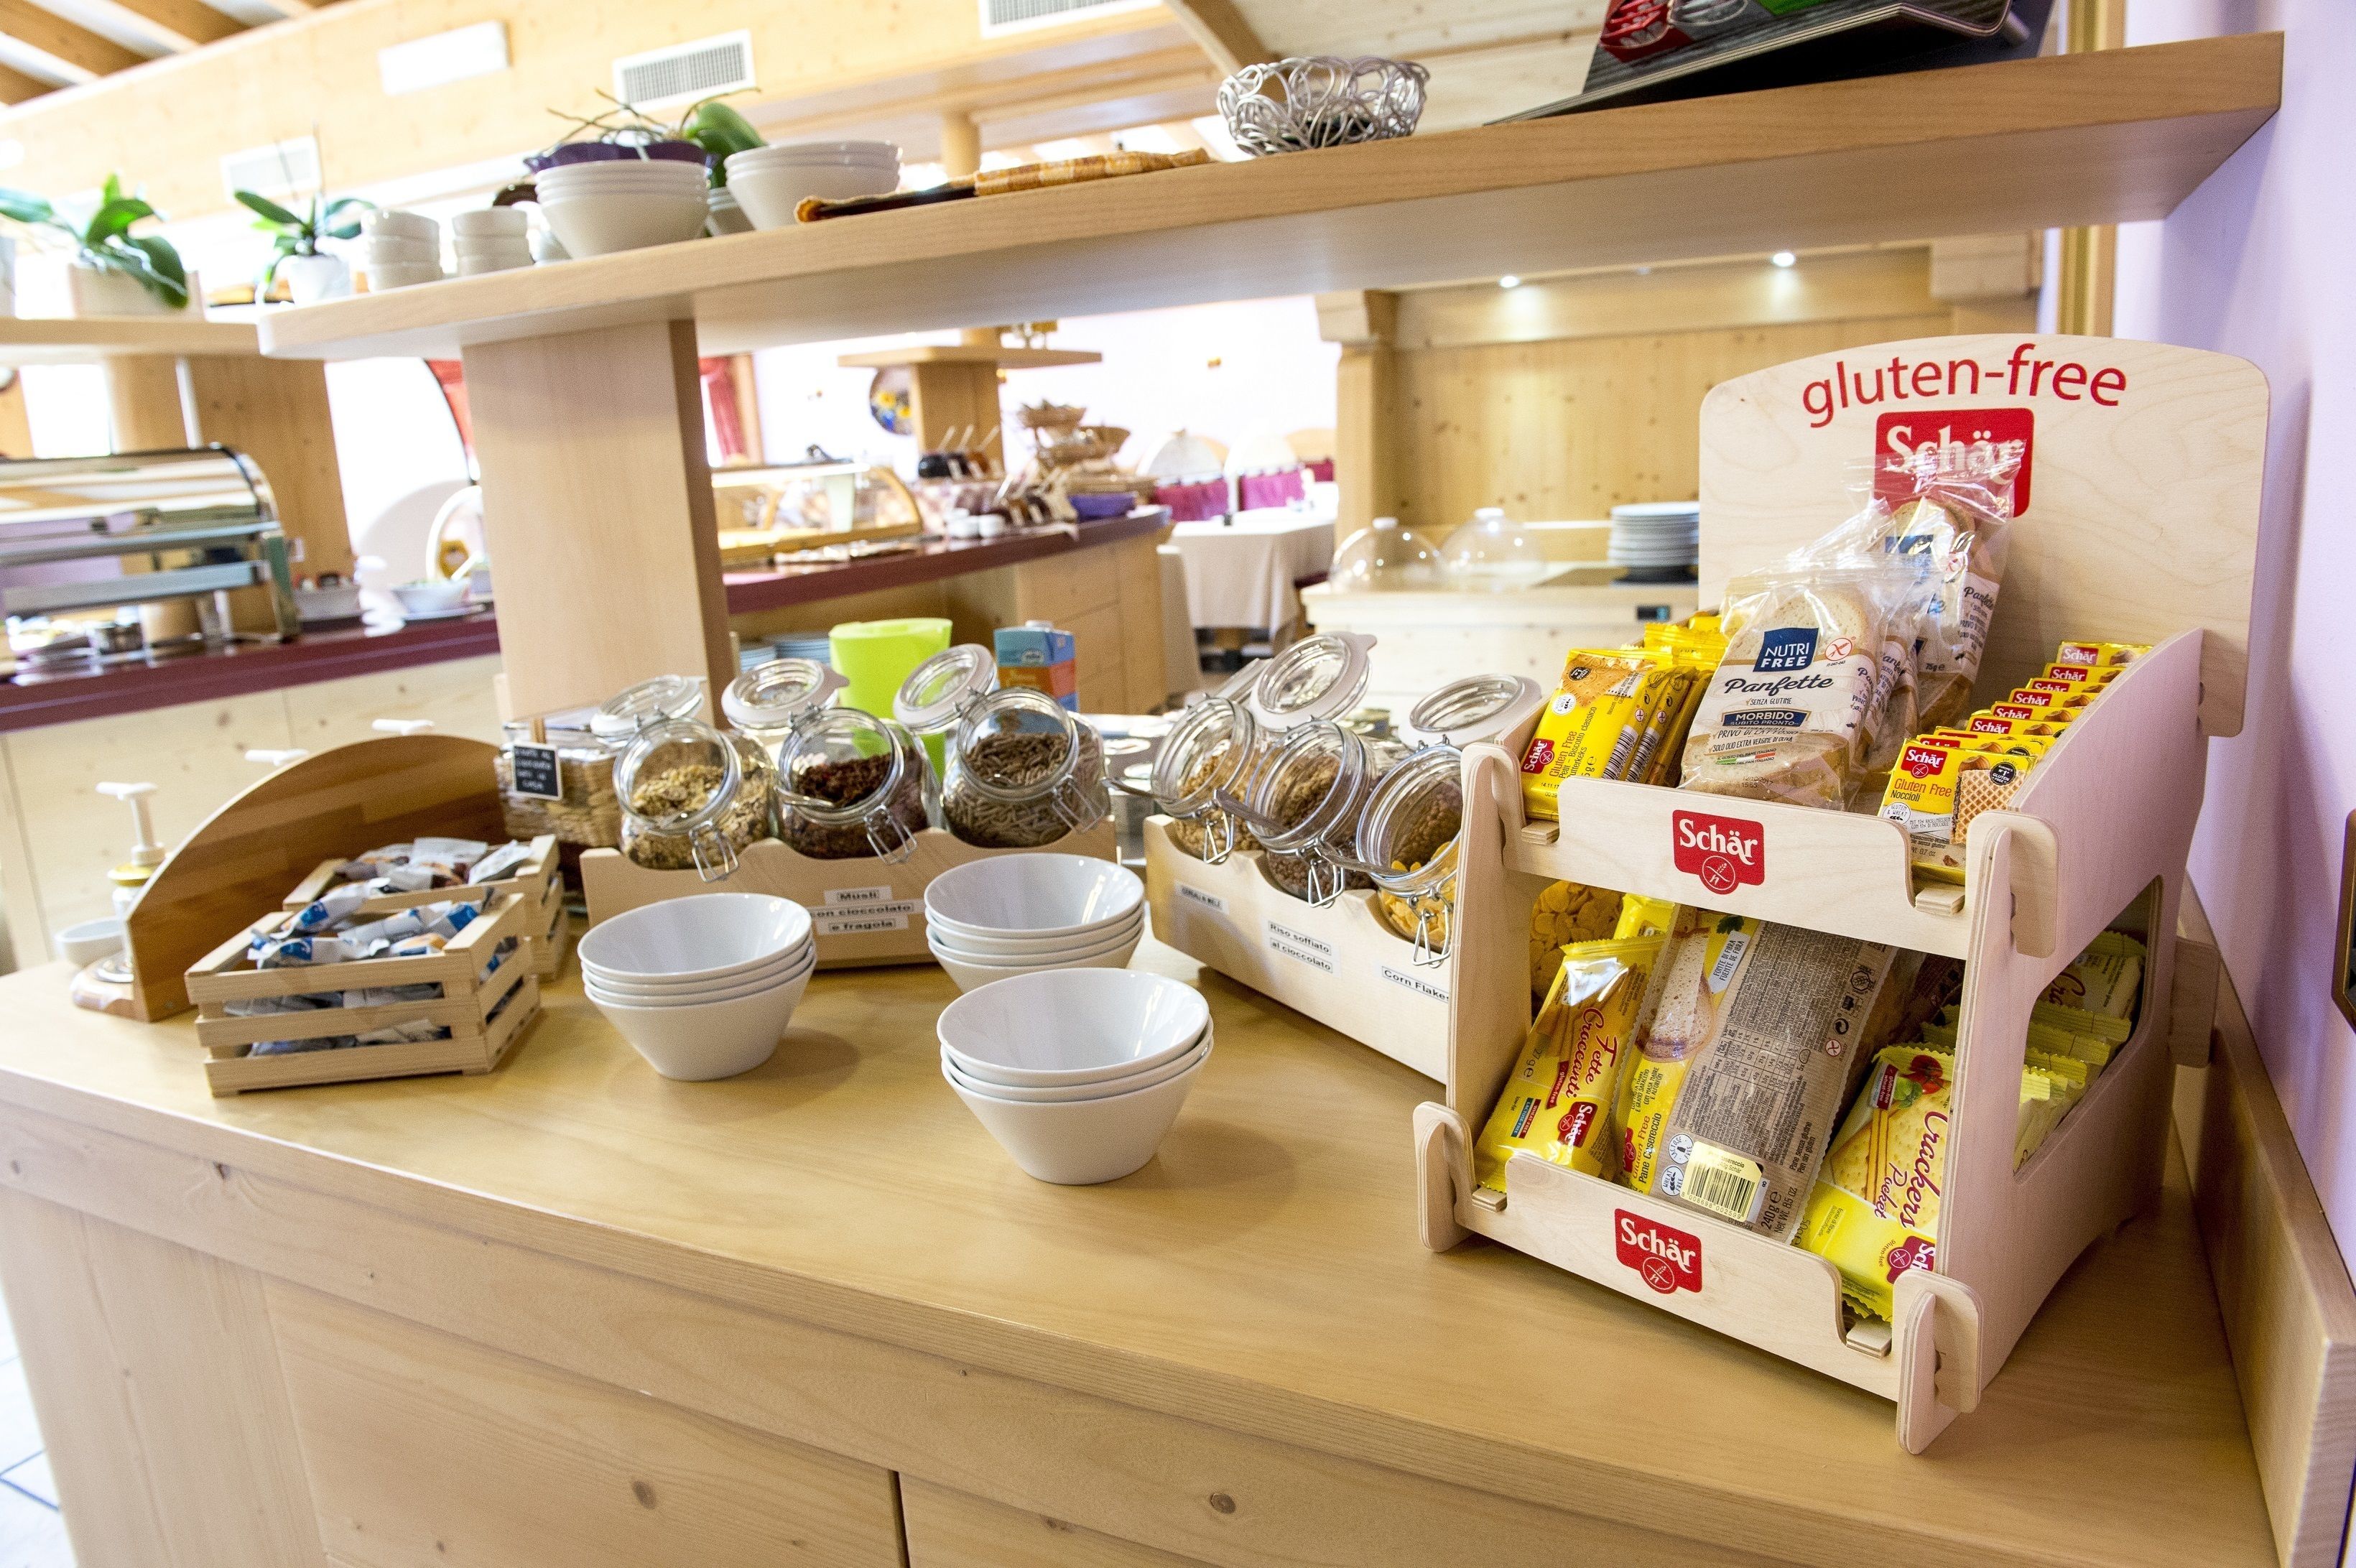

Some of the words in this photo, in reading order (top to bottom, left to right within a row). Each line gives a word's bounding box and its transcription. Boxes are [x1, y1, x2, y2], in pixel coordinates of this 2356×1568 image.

[1802, 343, 2126, 428] gluten-free
[1884, 424, 2026, 486] Schär
[1761, 657, 1807, 669] FREE
[1765, 642, 1810, 658] NUTRI
[2062, 648, 2097, 663] Schär
[1724, 674, 1834, 696] Panfette
[2051, 669, 2085, 682] Schär
[2014, 692, 2049, 706] Schär
[1735, 711, 1794, 721] MORBIDO
[1972, 720, 2009, 734] Schär
[1995, 708, 2029, 720] Schär
[1567, 729, 1585, 759] Biscotto
[1581, 706, 1597, 733] classico
[1717, 730, 1740, 739] PRIVO
[1736, 739, 1752, 748] EXTRA
[1523, 740, 1548, 771] Schär
[1549, 747, 1568, 778] Gluten
[1562, 730, 1577, 749] Free
[1906, 749, 1944, 768] Schär
[1890, 790, 1921, 802] Noccioli
[1894, 778, 1926, 793] Gluten
[1929, 783, 1952, 797] Free
[1679, 818, 1758, 866] Schär
[843, 920, 893, 930] fragola
[1271, 922, 1291, 937] Riso
[1293, 932, 1330, 953] soffiato
[1281, 945, 1332, 971] cioccolato
[1712, 960, 1725, 977] FONTE
[1725, 940, 1736, 954] FIBRA
[1719, 962, 1734, 981] FUENTE
[1733, 940, 1745, 954] FIBRA
[1383, 969, 1412, 987] Corn
[1564, 1007, 1605, 1100] Croccanti
[1584, 1034, 1619, 1085] Fette
[1640, 1069, 1650, 1093] SARACENO
[1651, 1066, 1660, 1083] MADRE
[1883, 1067, 1895, 1104] gluten-free
[1546, 1070, 1566, 1108] gluten-free
[1563, 1104, 1593, 1147] Schär
[1637, 1115, 1651, 1141] Free
[1643, 1113, 1662, 1159] Casereccio
[1673, 1136, 1682, 1159] LACTOSE
[1789, 1155, 1799, 1171] Pane
[1795, 1139, 1806, 1157] senza
[1801, 1121, 1813, 1141] glutine
[1796, 1162, 1806, 1174] Pan
[1807, 1136, 1817, 1155] gluten
[1638, 1162, 1650, 1184] Pane
[1662, 1170, 1673, 1188] WHEAT
[1902, 1110, 1948, 1228] Crackers
[1874, 1161, 1908, 1220] Pocket
[1689, 1194, 1713, 1209] 008698
[1716, 1205, 1742, 1220] 002599
[1774, 1221, 1786, 1234] Net
[1782, 1197, 1794, 1210] 8.5
[1620, 1217, 1697, 1274] Schär
[1879, 1238, 1896, 1268] gluten-free
